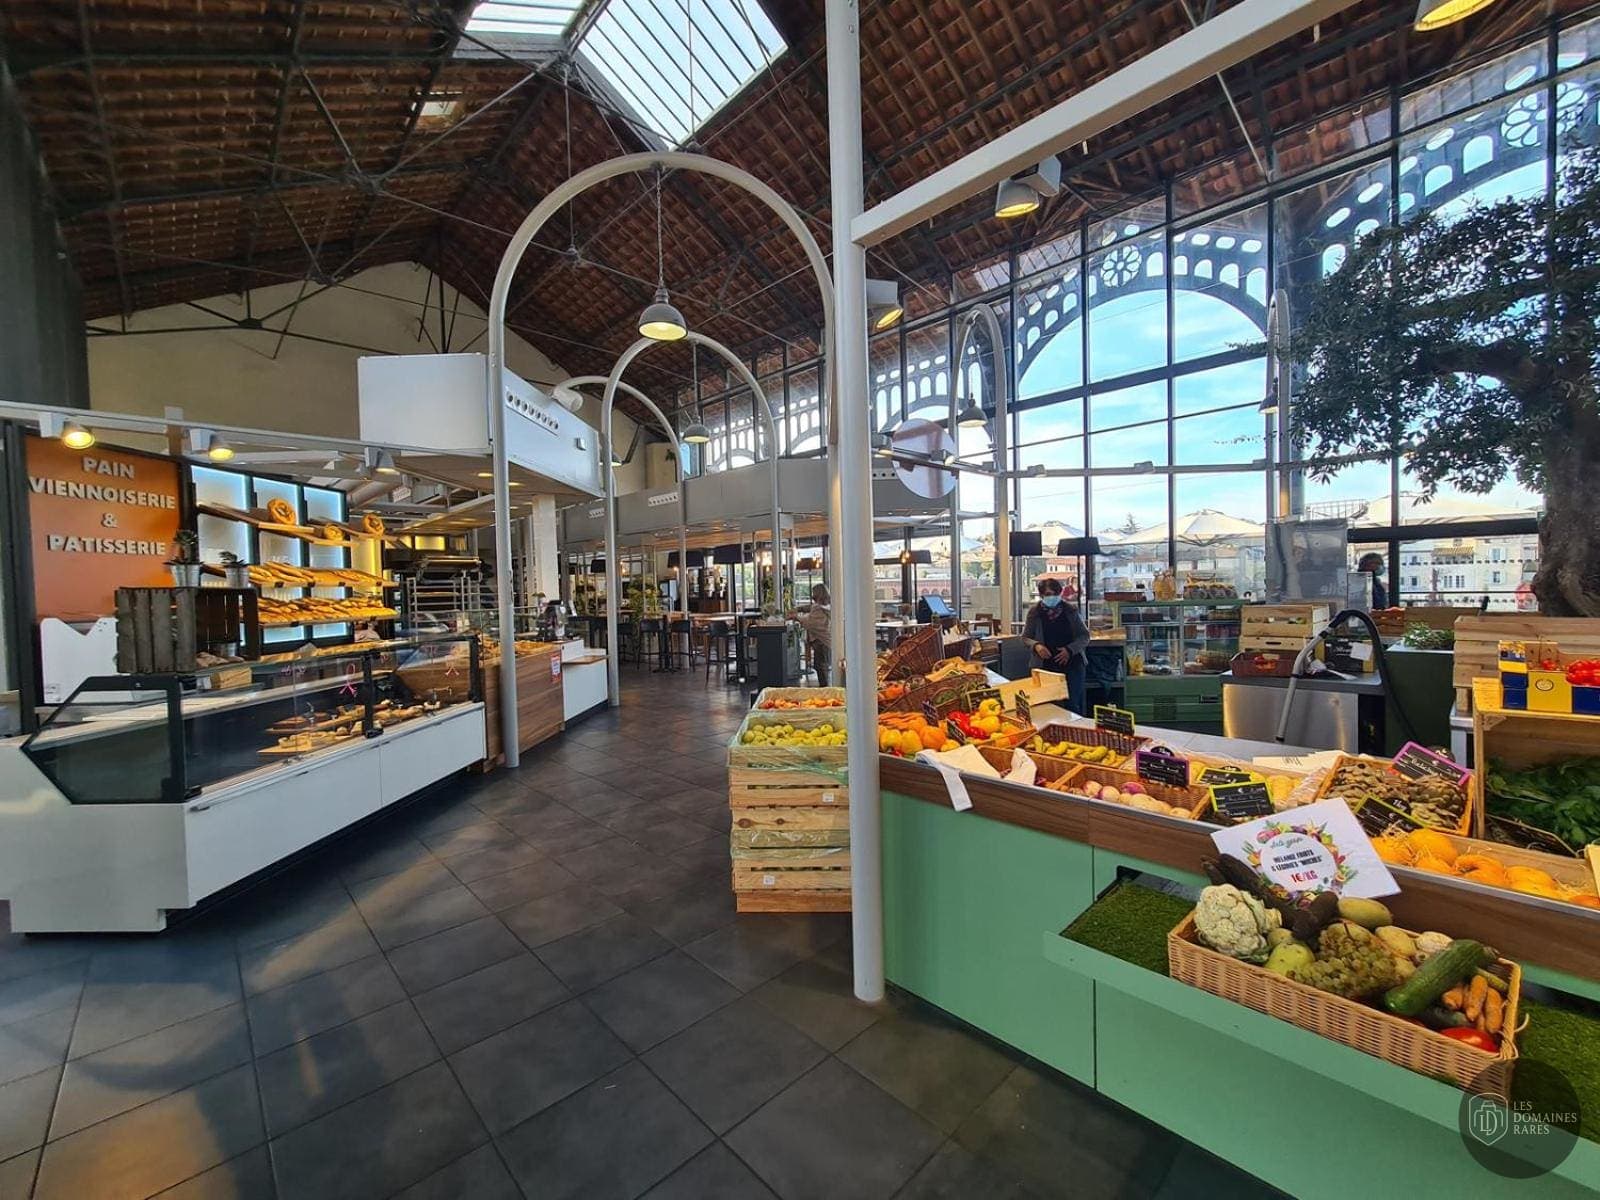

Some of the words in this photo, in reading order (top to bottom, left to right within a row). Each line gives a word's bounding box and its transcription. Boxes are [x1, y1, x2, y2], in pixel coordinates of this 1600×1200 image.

[82, 457, 135, 479] PAIN
[29, 476, 176, 509] VIENNOISERIE
[101, 512, 119, 529] &
[48, 534, 166, 555] PATISSERIE
